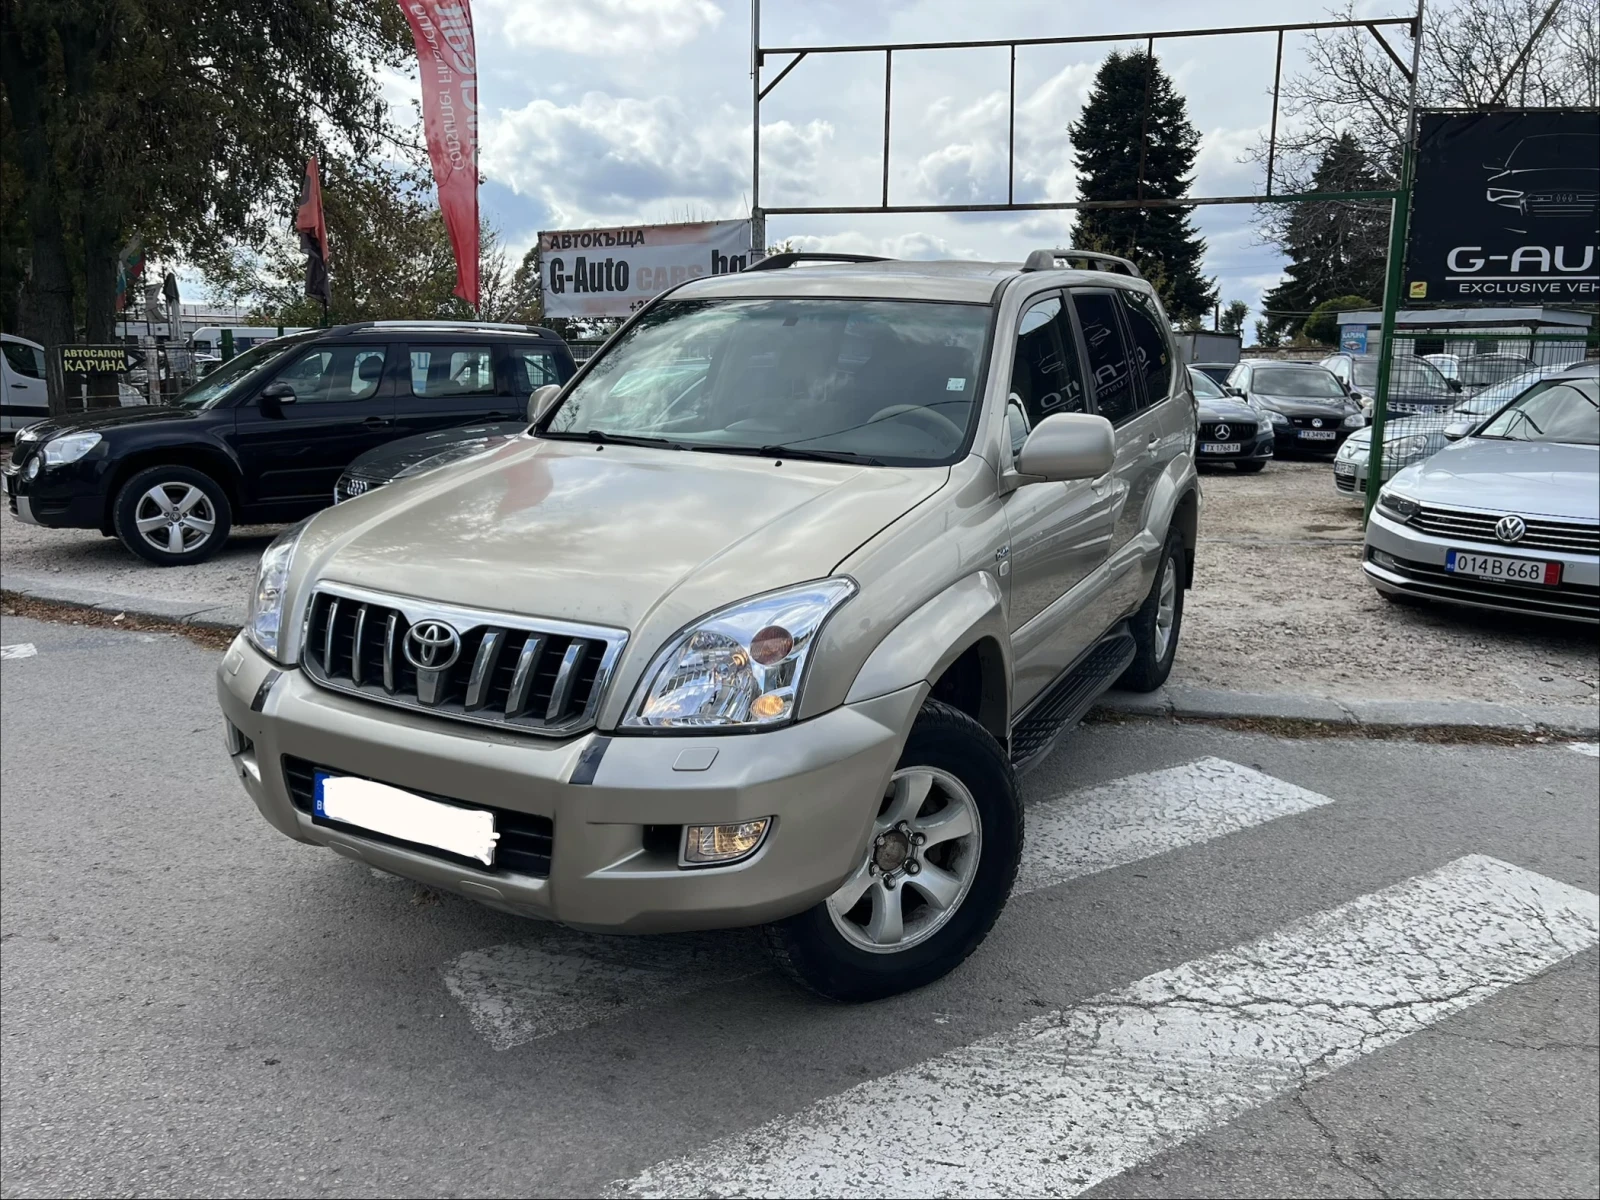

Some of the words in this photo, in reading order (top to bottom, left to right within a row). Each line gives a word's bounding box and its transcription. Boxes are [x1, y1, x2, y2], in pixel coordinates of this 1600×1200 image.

[550, 230, 645, 250] АВТОКЪЩА
[1447, 246, 1599, 272] G-AU
[550, 256, 629, 294] G-Auto
[1459, 283, 1561, 293] EXCLUSIVE
[64, 349, 125, 358] АВТОСАЛОН
[64, 360, 127, 371] КАРИНА
